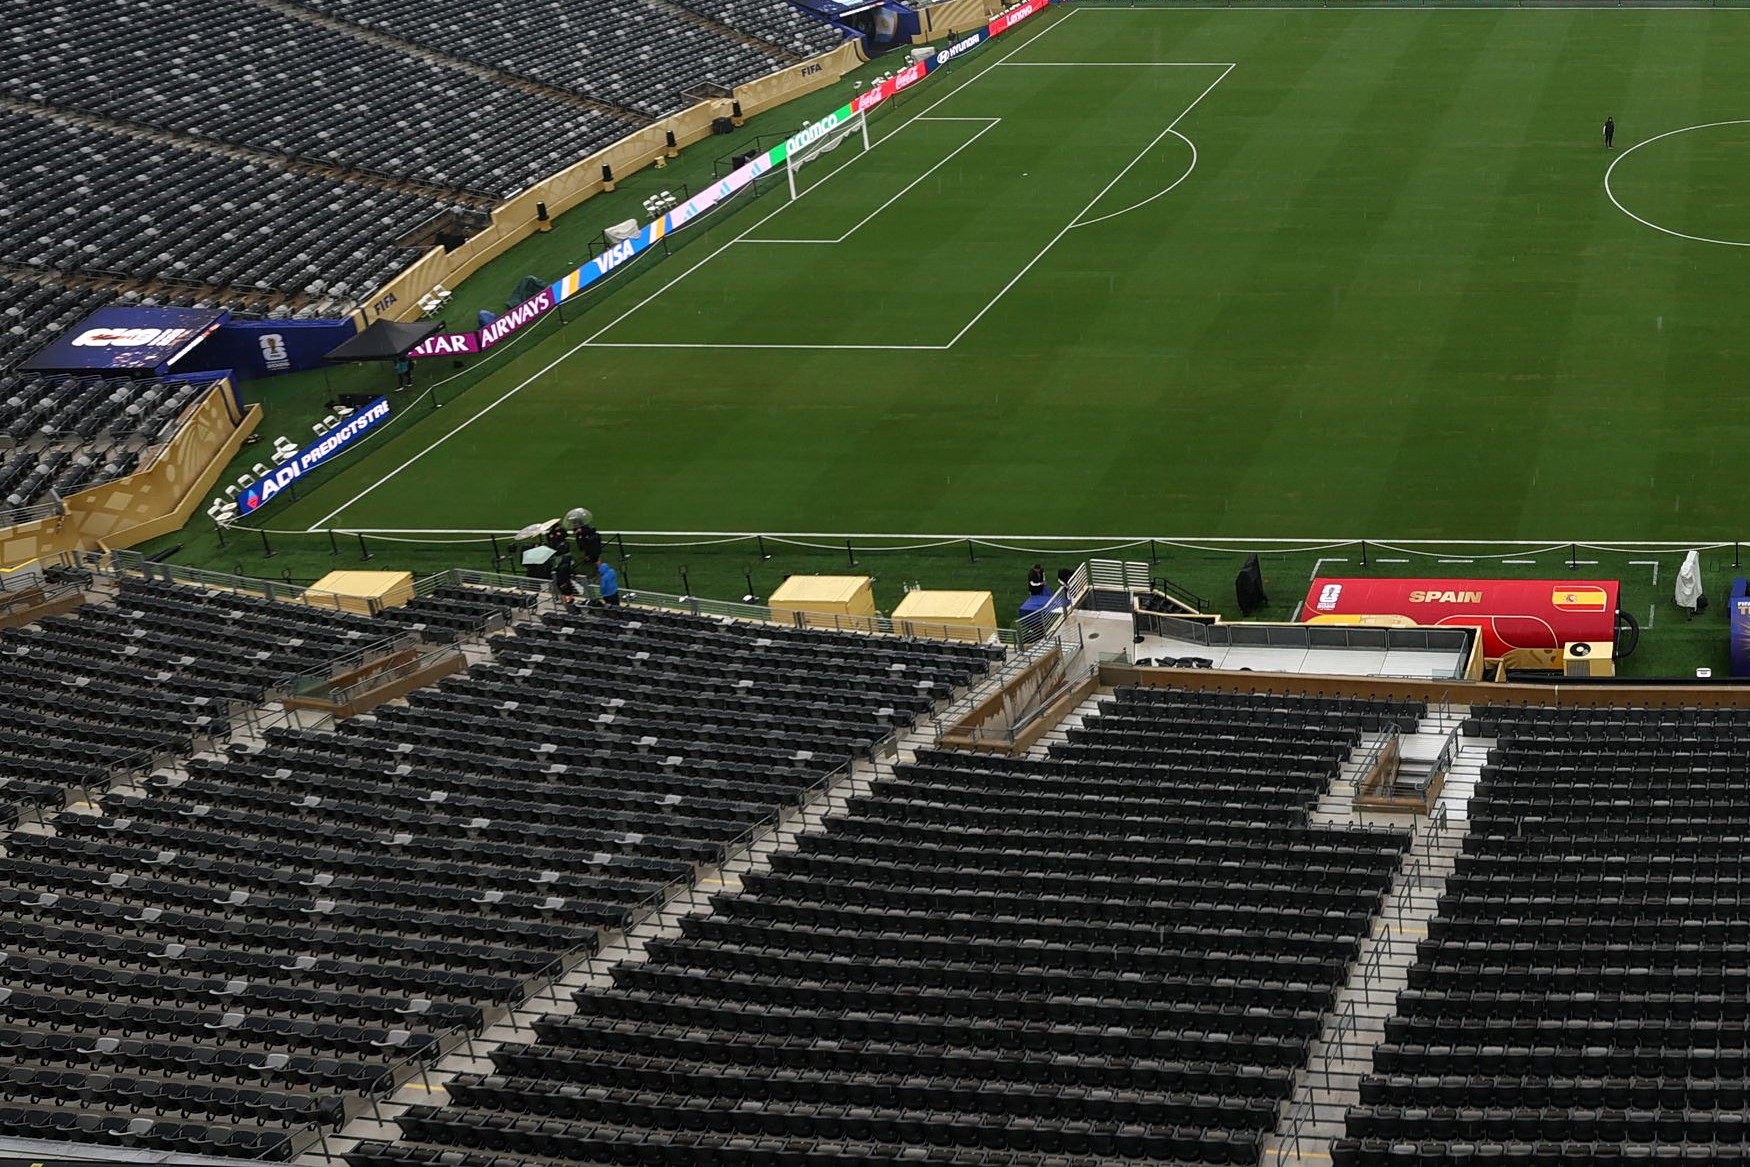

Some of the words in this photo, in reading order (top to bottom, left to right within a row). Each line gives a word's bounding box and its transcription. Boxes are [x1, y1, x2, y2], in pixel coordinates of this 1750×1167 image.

[1006, 5, 1033, 26] Lenovo
[949, 33, 980, 57] HYUNDAI
[801, 63, 823, 77] FIFA
[785, 113, 838, 154] aramco
[594, 239, 635, 274] VISA
[374, 292, 397, 316] FIFA
[408, 335, 469, 355] TAR
[481, 292, 549, 348] AIRWAYS
[261, 461, 301, 501] ADI
[301, 400, 390, 469] PREDICTSTRE
[1409, 591, 1482, 603] SPAIN
